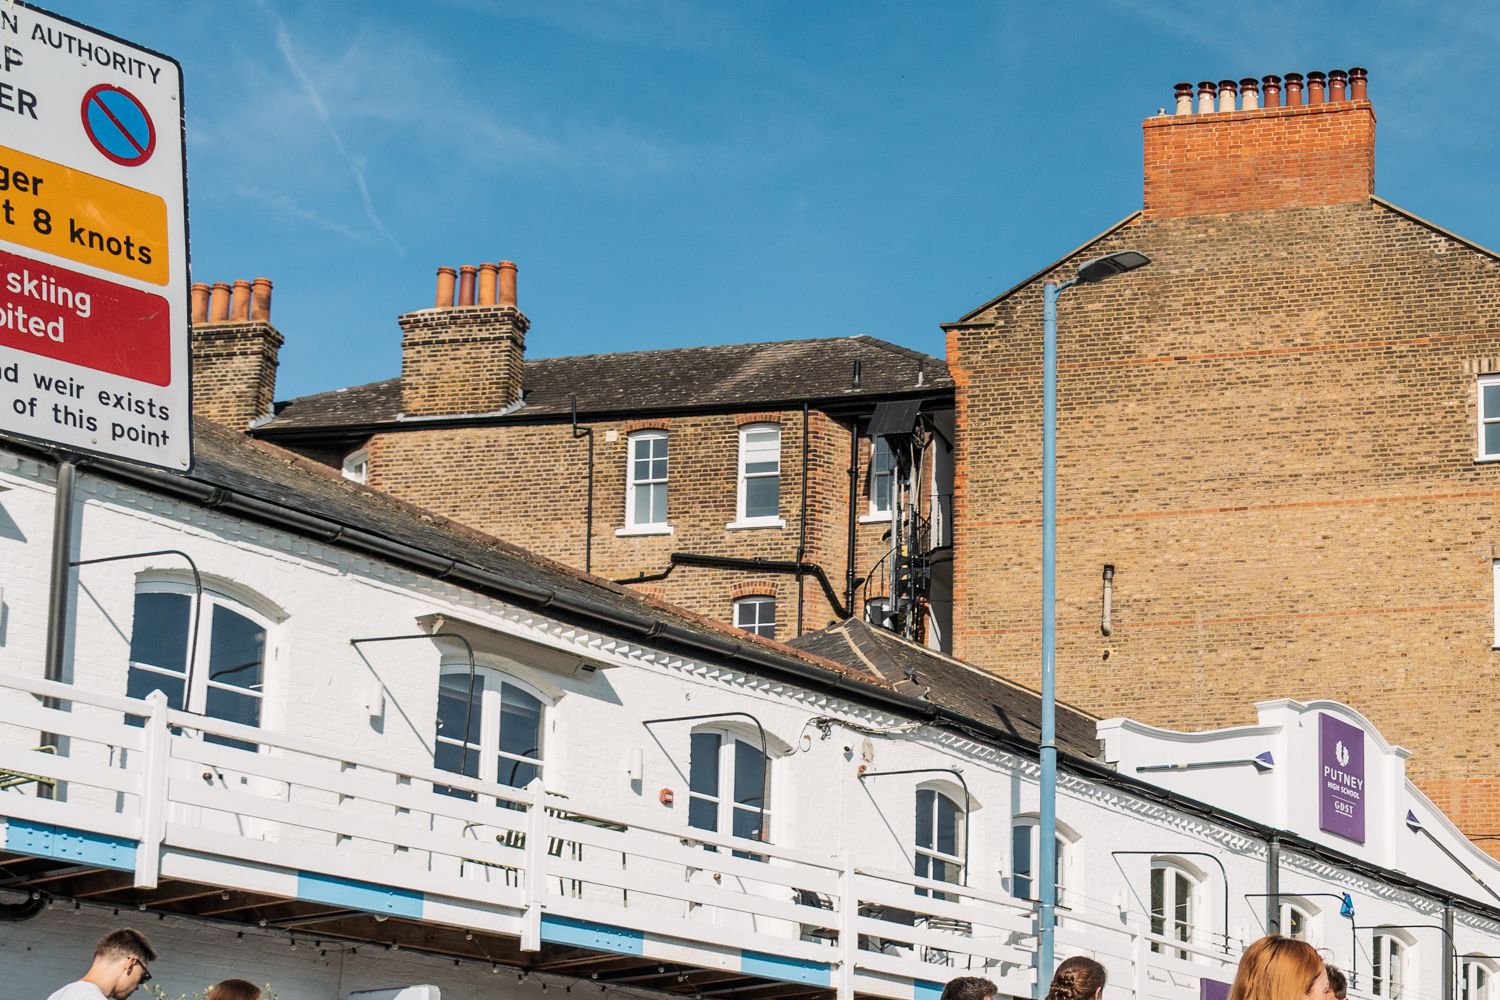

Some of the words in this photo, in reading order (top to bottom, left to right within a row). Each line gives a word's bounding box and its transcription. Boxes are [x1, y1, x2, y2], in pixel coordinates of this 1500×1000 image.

[31, 23, 161, 84] AUTHORITY
[33, 208, 52, 235] 8
[69, 218, 152, 265] knots
[6, 269, 91, 318] skiing
[33, 373, 85, 399] weir
[98, 390, 169, 421] exists
[13, 397, 37, 417] of
[52, 403, 98, 432] this
[112, 422, 170, 447] point
[1324, 766, 1363, 790] PUTNEY
[1327, 781, 1340, 792] HIGH
[1340, 786, 1360, 799] SCHOOL
[1334, 800, 1354, 814] GDST
